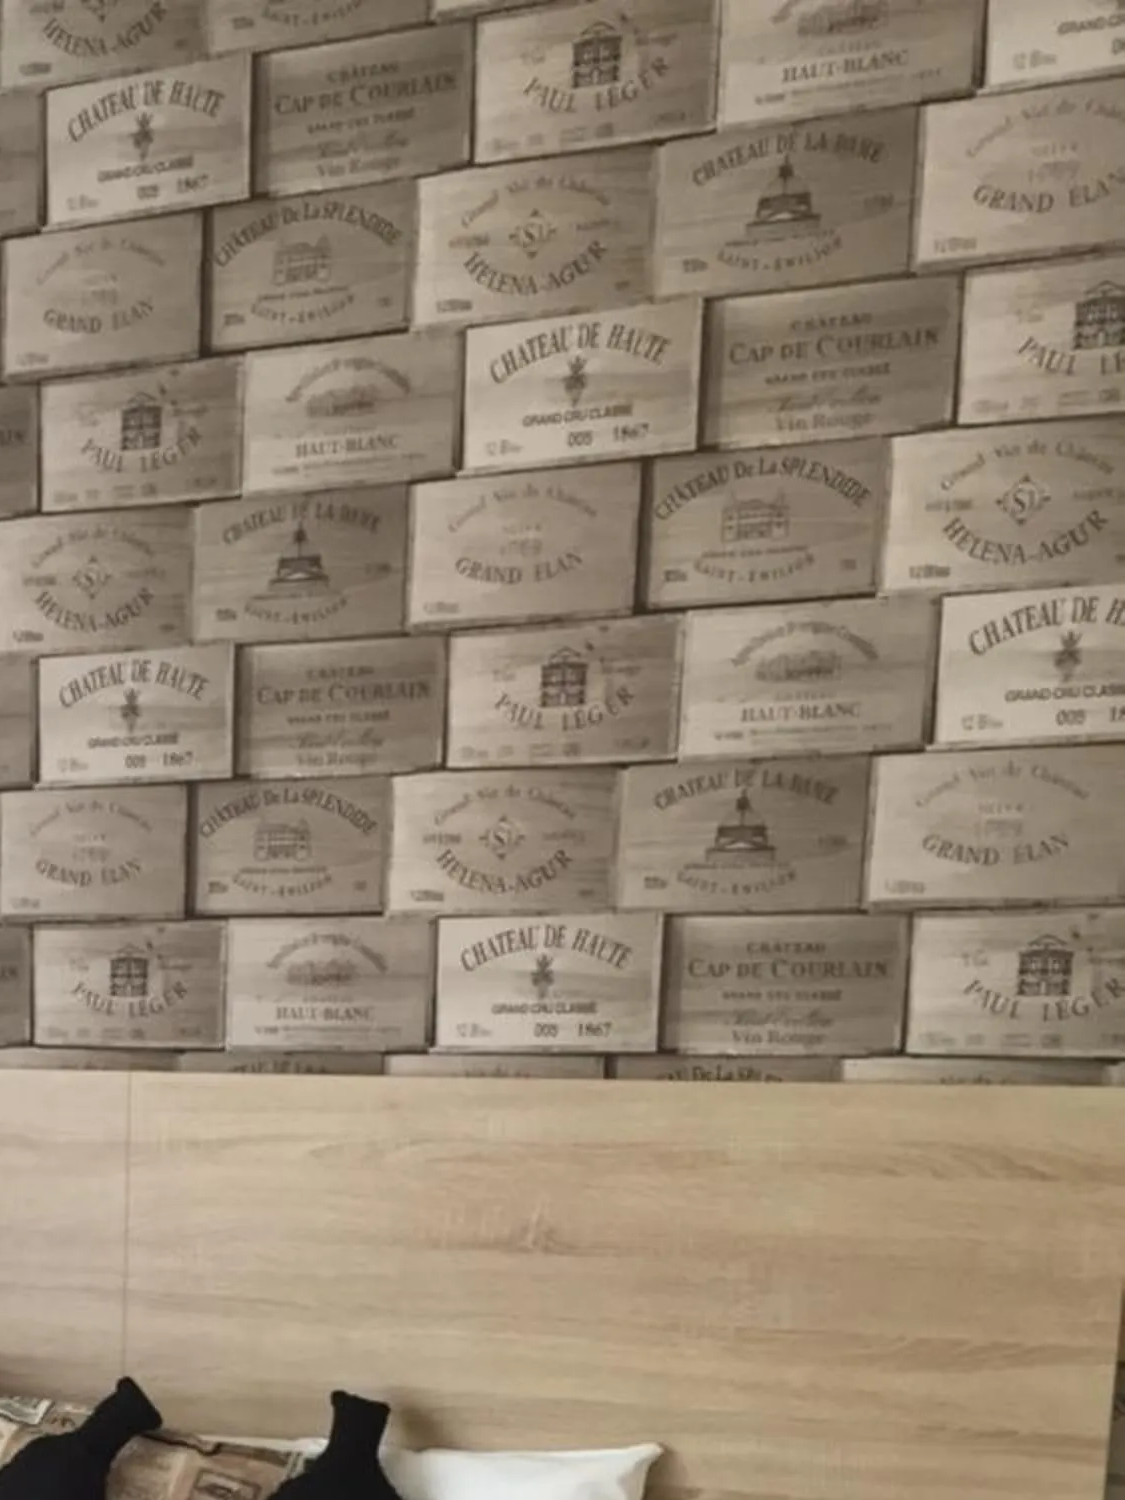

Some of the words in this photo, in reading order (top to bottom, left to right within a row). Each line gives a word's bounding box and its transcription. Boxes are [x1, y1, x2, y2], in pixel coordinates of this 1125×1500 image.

[488, 325, 572, 385] CHATEAU
[578, 321, 602, 350] DE
[606, 322, 672, 368] HAUTE
[968, 597, 1065, 657] CHATEAU
[1071, 596, 1100, 624] DE
[459, 924, 539, 975] CHATEAU
[543, 923, 567, 950] DE
[571, 924, 634, 972] HAUTE
